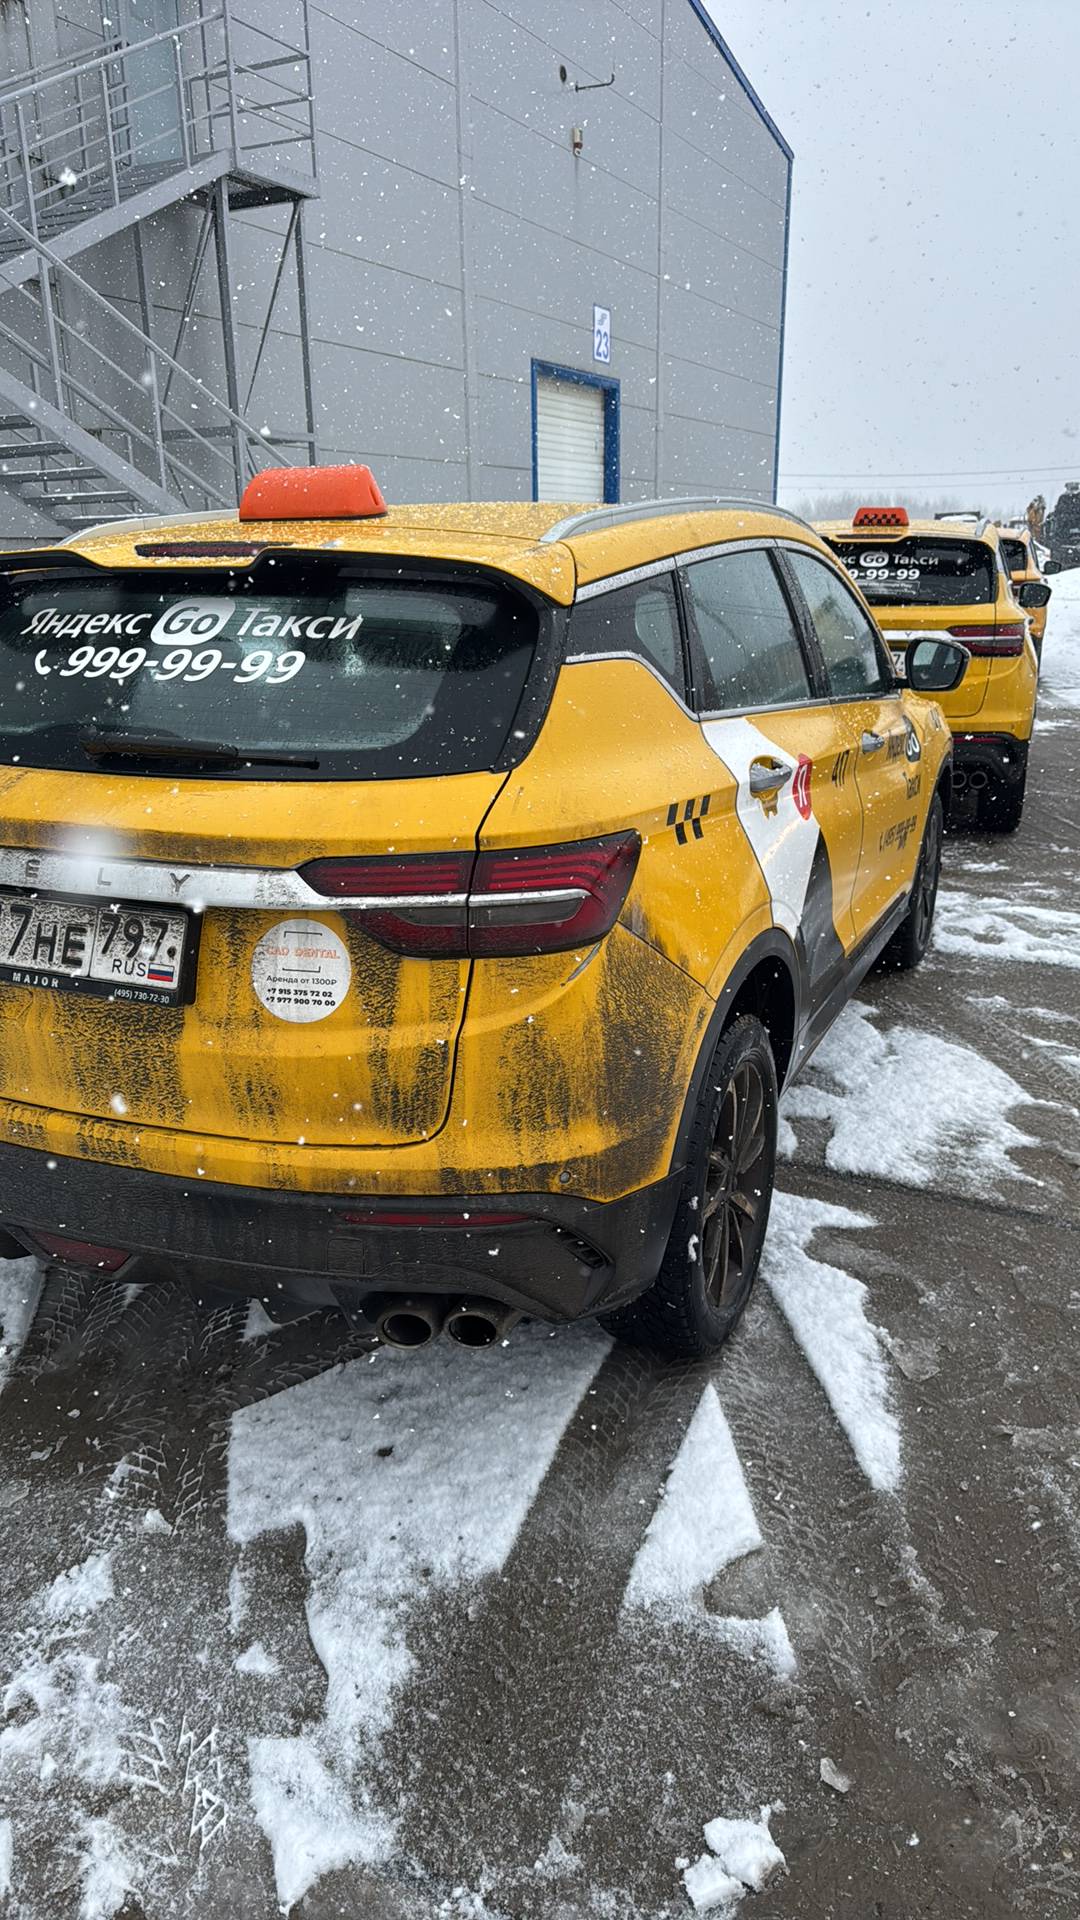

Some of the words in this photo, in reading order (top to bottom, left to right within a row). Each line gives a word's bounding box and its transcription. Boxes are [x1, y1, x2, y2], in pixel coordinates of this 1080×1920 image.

[596, 329, 608, 359] 23
[863, 553, 886, 564] Go
[893, 553, 939, 566] Такси
[20, 607, 152, 639] Яндекс
[162, 605, 223, 636] Go
[236, 606, 363, 640] Такси
[59, 646, 306, 684] 999-99-99
[100, 912, 169, 961] 797
[112, 959, 146, 978] RUS
[12, 972, 59, 988] MAJOR
[266, 975, 298, 985] Аренда
[114, 989, 133, 999] (495)
[278, 988, 291, 996] 915
